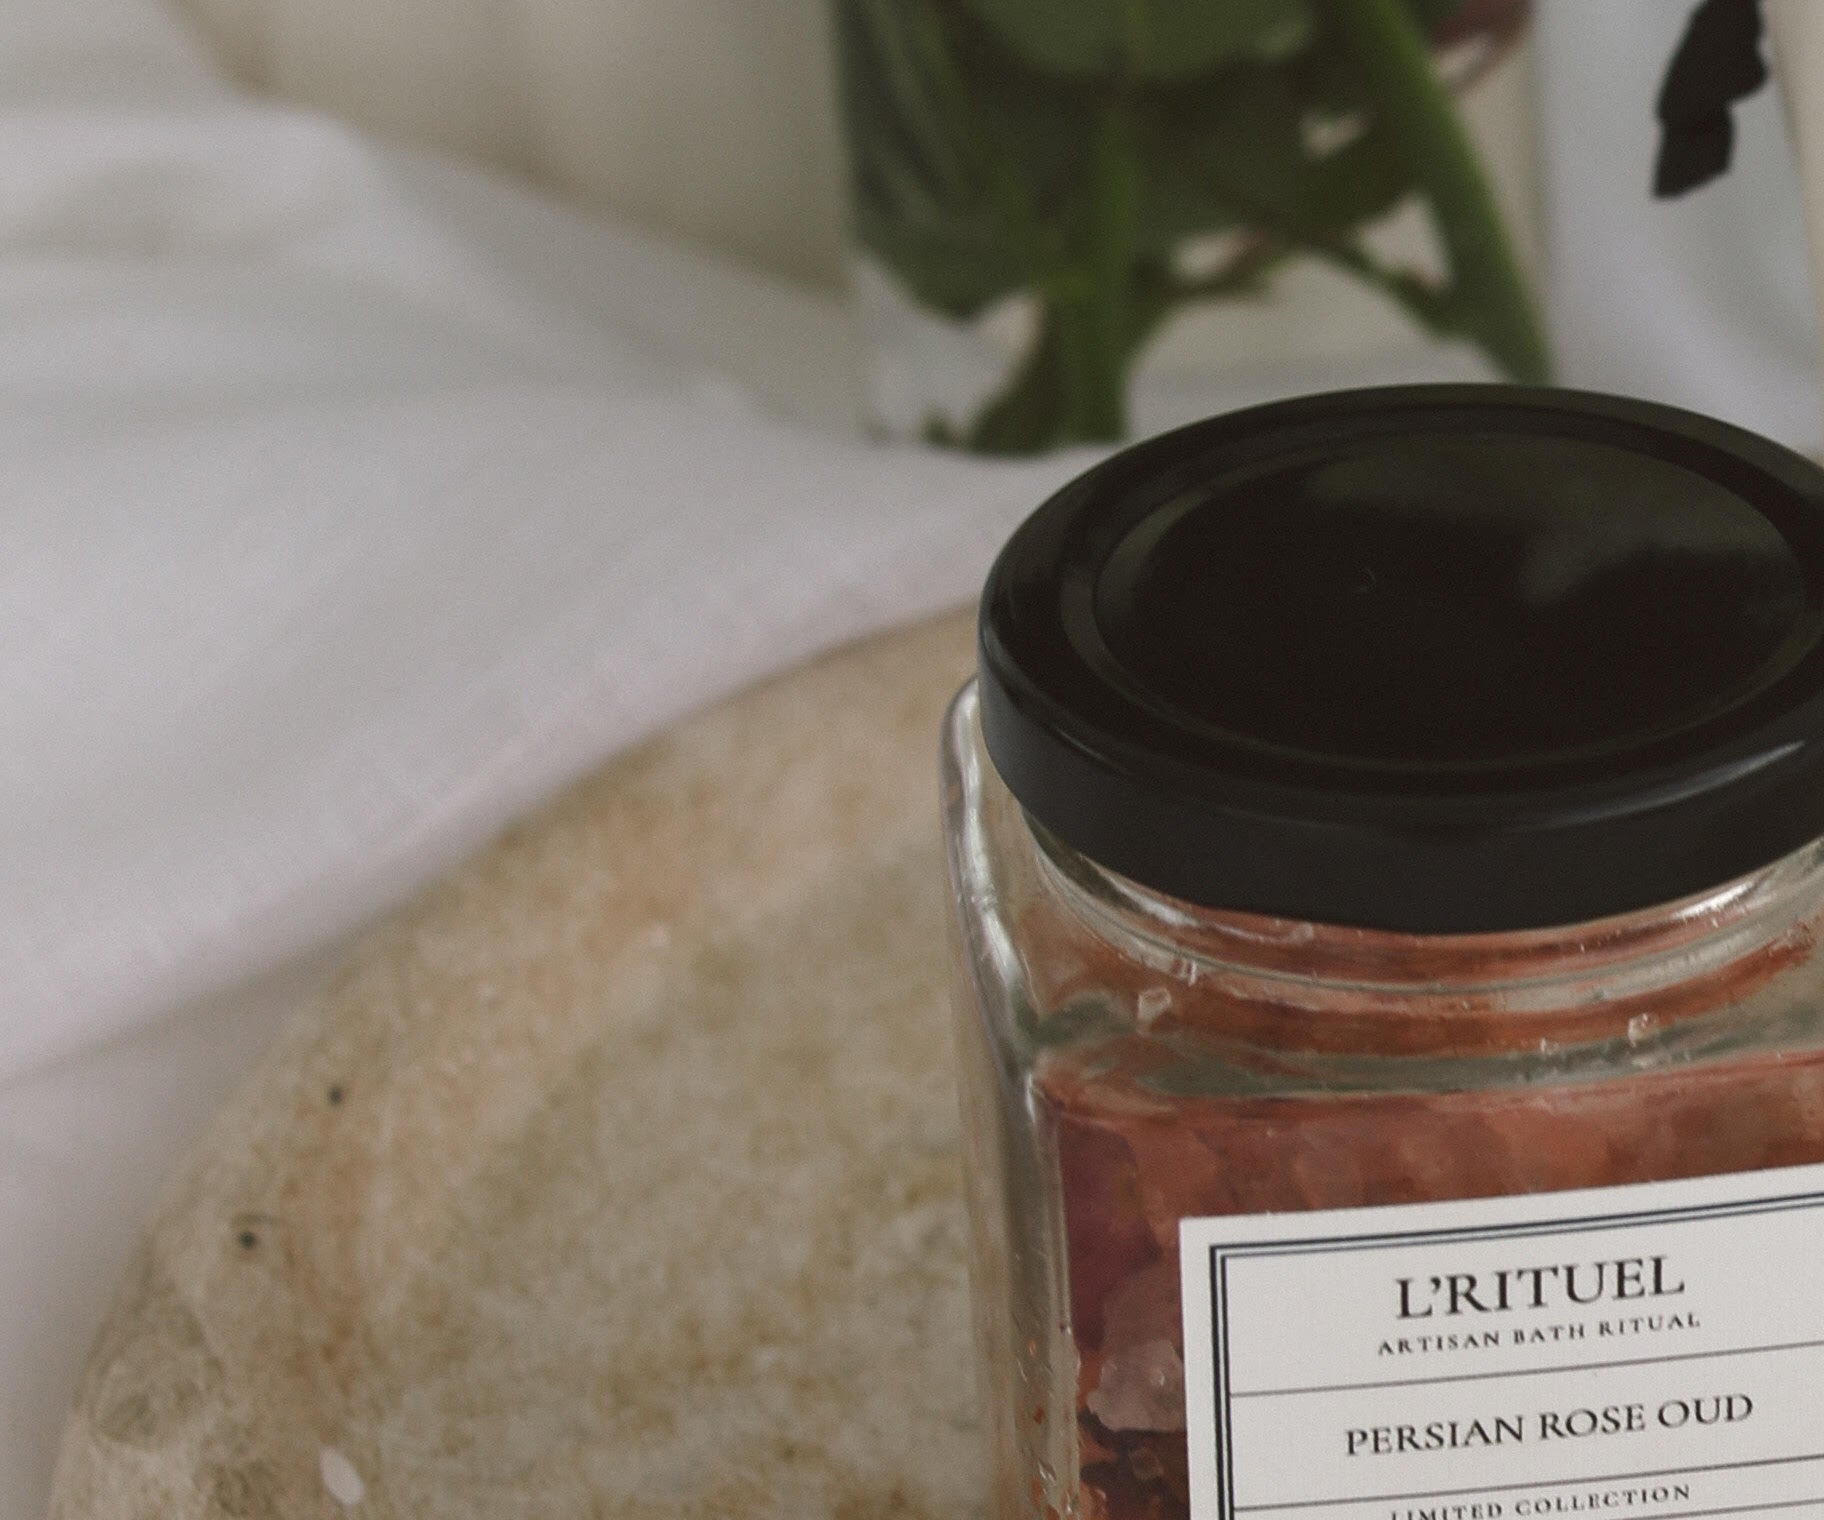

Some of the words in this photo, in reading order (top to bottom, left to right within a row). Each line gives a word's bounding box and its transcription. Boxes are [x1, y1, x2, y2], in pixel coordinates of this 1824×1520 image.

[1395, 1255, 1686, 1320] L'RITUEL
[1377, 1329, 1501, 1357] ARTISAN
[1512, 1321, 1586, 1346] BATH
[1598, 1311, 1701, 1338] RITUAL
[1345, 1414, 1525, 1458] PERSIAN
[1538, 1403, 1647, 1442] ROSE
[1656, 1392, 1755, 1429] OUD
[1513, 1483, 1691, 1517] COLLECTION
